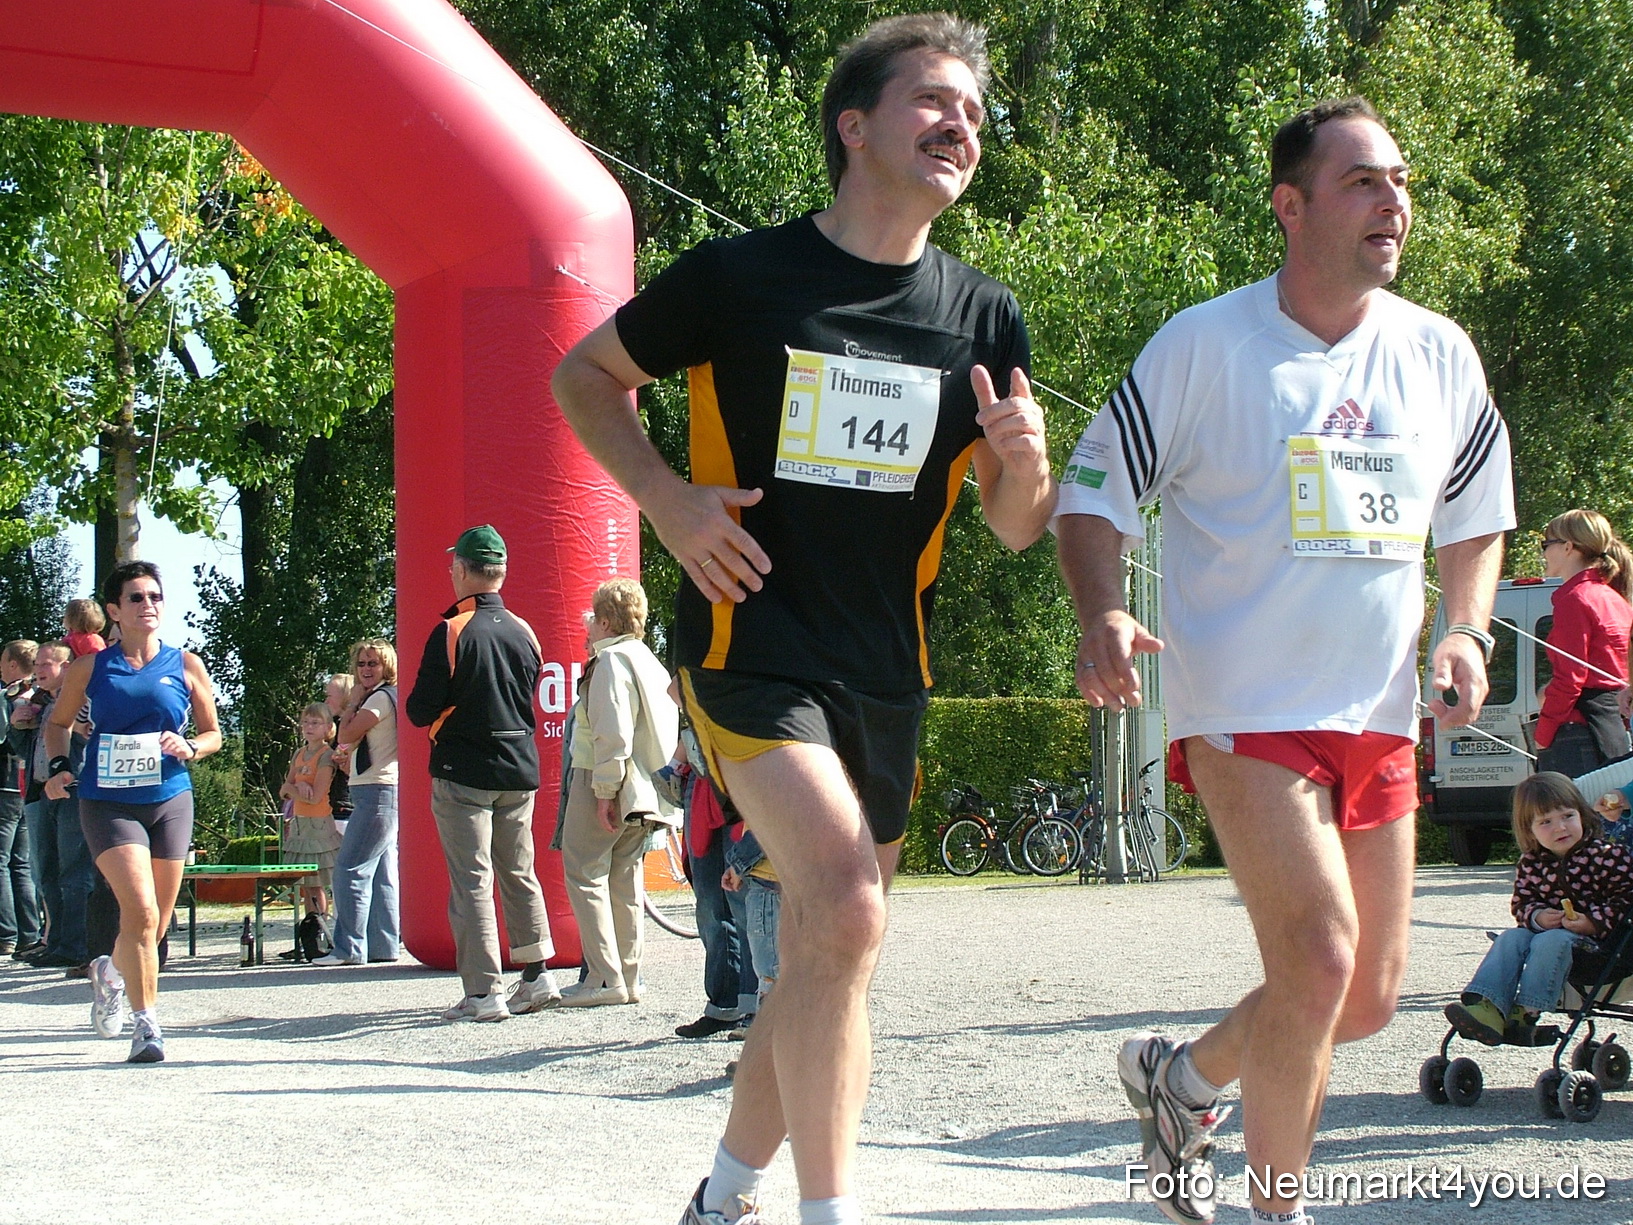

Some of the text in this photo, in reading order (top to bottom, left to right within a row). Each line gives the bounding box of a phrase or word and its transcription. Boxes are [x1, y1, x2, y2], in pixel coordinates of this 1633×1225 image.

[829, 366, 903, 400] Thomas
[788, 400, 799, 418] D
[1323, 418, 1375, 432] adidas
[841, 415, 910, 456] 144
[778, 459, 837, 478] BOCK
[1331, 450, 1394, 473] Markus
[1298, 483, 1308, 500] C
[1358, 492, 1399, 525] 38
[1295, 539, 1351, 551] BOCK
[113, 740, 141, 751] Karola
[1457, 743, 1471, 752] NM
[1476, 742, 1490, 752] BS
[114, 756, 156, 773] 2750
[1449, 766, 1514, 774] ANSCHLAGKETTEN
[1449, 773, 1500, 781] BINDESTRICKE
